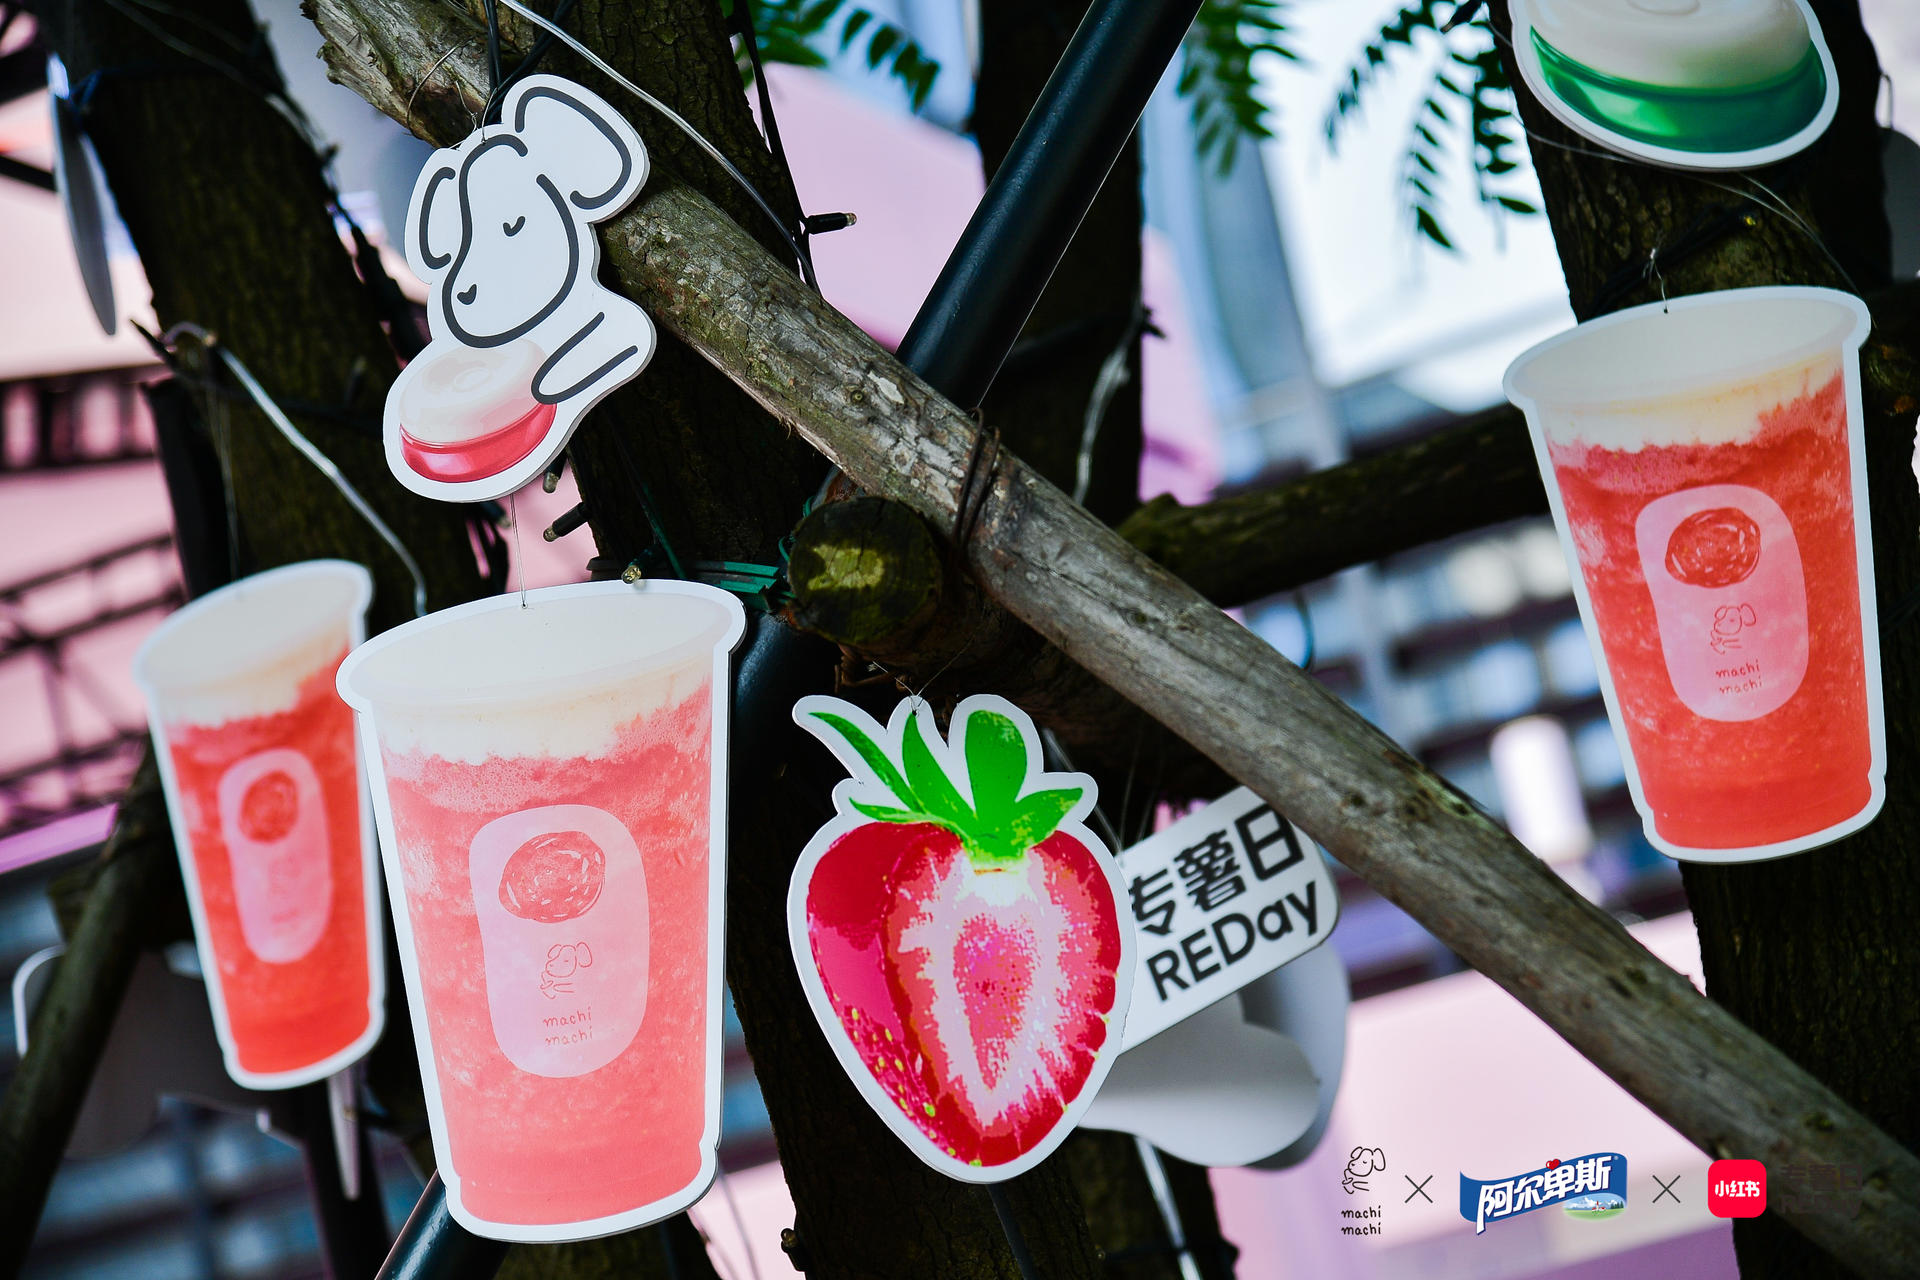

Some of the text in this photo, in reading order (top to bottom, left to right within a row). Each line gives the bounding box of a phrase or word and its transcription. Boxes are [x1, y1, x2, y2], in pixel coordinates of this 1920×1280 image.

[1715, 658, 1760, 677] machi
[1720, 675, 1763, 694] machi
[1128, 804, 1304, 935] 专薯日
[1146, 881, 1318, 1001] REDay
[543, 1006, 592, 1027] machi
[545, 1025, 593, 1045] machi
